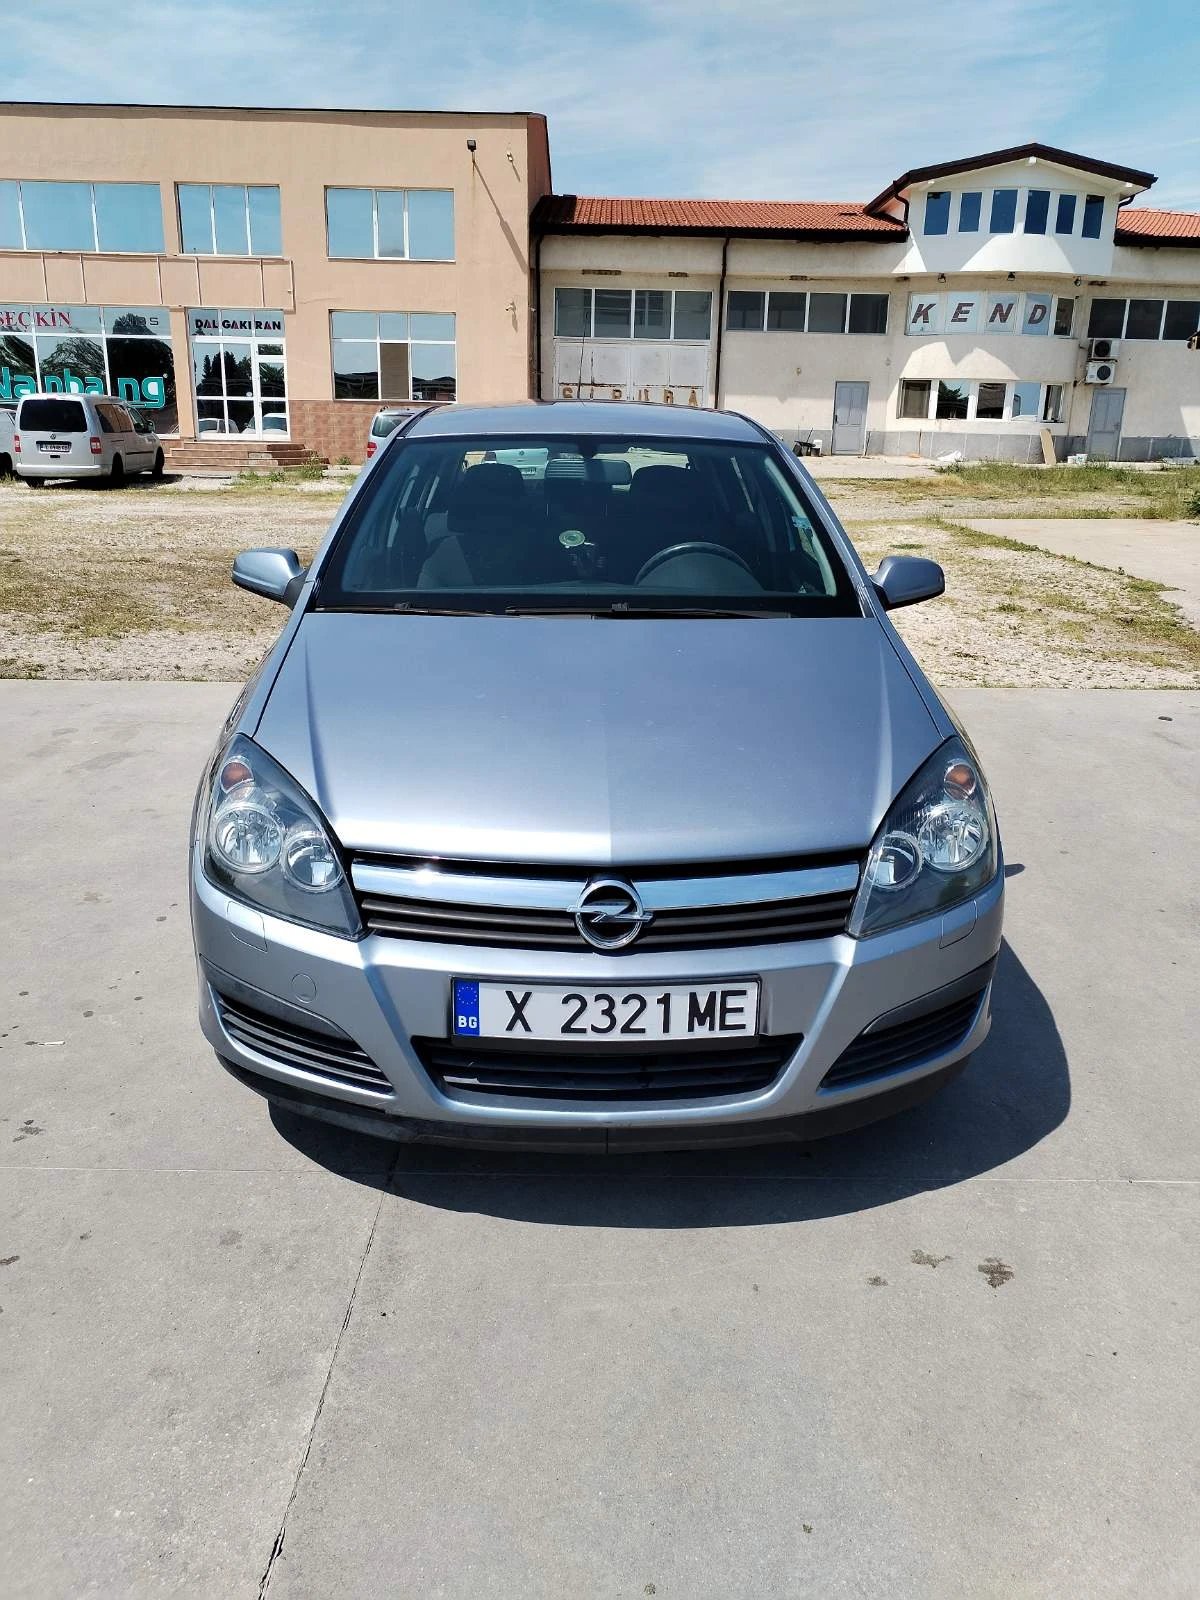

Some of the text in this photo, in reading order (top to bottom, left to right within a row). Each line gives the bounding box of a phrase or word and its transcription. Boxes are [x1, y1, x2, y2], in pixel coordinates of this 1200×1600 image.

[911, 302, 1047, 325] KEND
[457, 1015, 478, 1029] BG
[505, 989, 748, 1034] X 2321 ME
